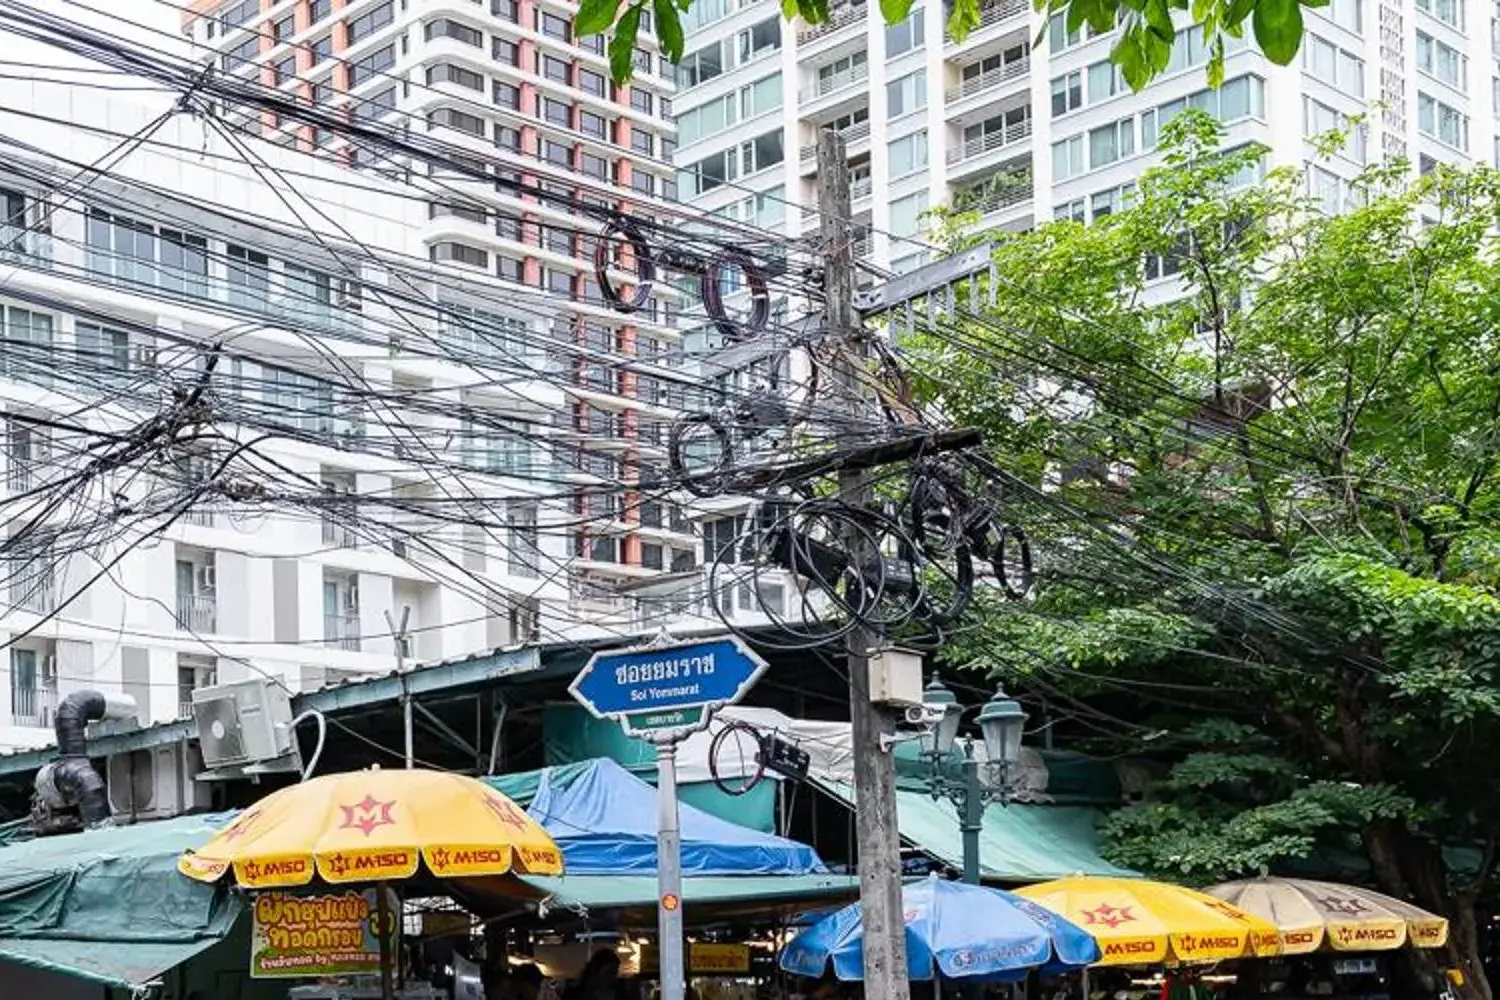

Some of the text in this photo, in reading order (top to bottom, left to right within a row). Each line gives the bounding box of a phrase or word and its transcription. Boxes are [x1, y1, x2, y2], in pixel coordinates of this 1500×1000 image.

[615, 653, 715, 685] ซอยยมราช
[630, 683, 700, 701] Soi Yommarat
